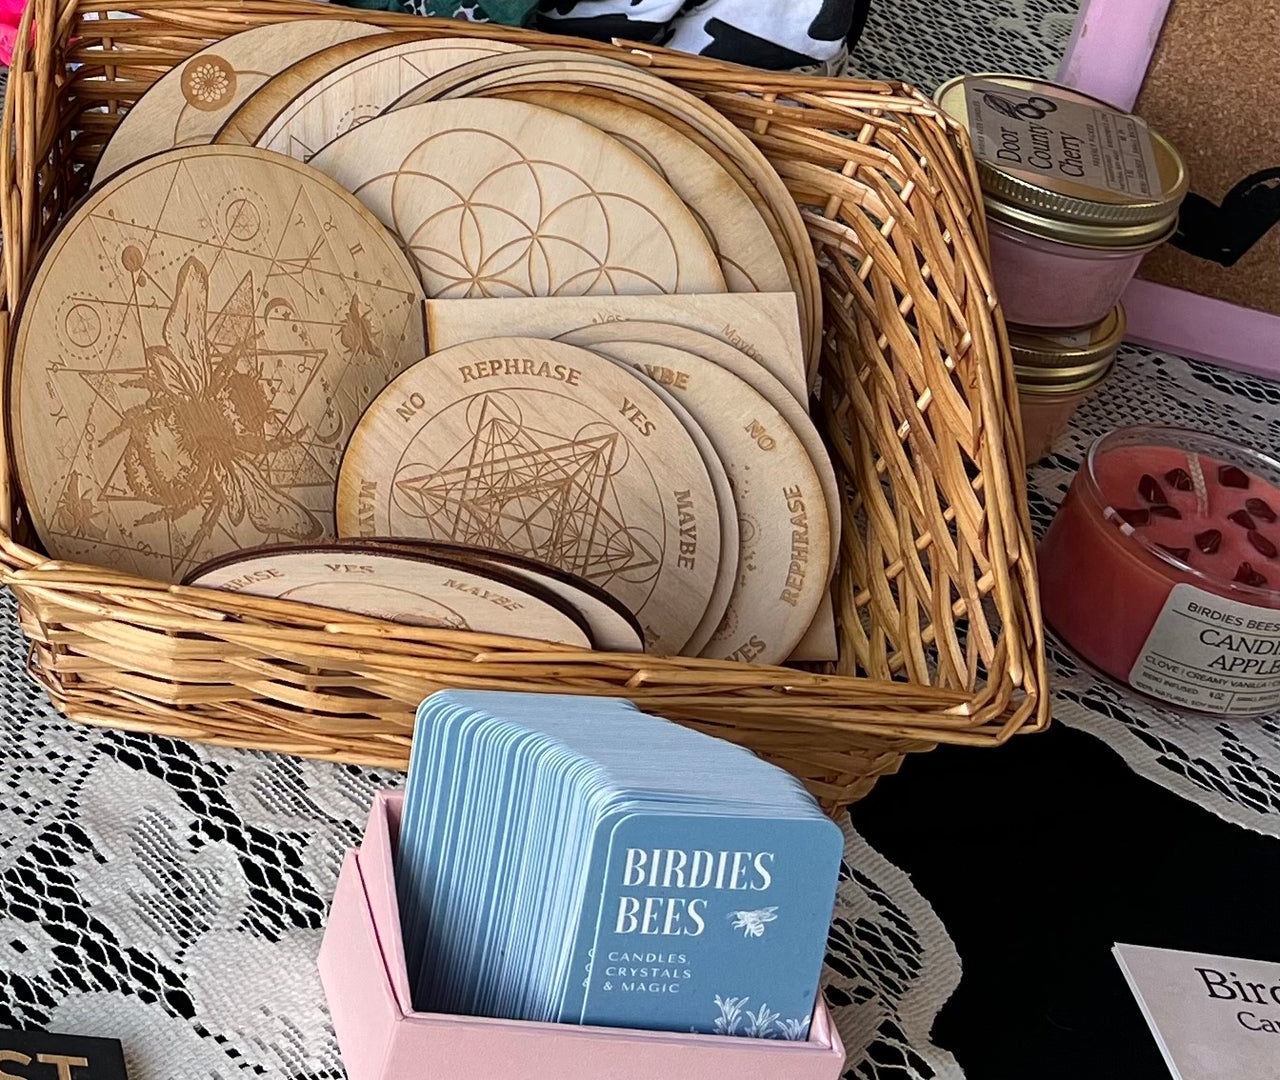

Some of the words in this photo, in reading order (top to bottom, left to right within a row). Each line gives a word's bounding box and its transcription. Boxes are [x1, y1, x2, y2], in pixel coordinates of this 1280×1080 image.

[996, 127, 1022, 164] Door
[1028, 122, 1054, 170] County
[1059, 131, 1085, 177] Cherry
[458, 358, 582, 388] REPHRASE
[395, 391, 426, 423] NO
[618, 397, 657, 438] YES
[743, 418, 777, 452] NO
[674, 489, 696, 571] MAYBE
[779, 483, 811, 608] REPHRASE
[325, 563, 375, 574] YES
[443, 578, 524, 611] MAYBE
[1188, 602, 1244, 626] BIRDIES
[1246, 620, 1280, 631] BEES
[1145, 655, 1179, 673] CLOVE
[622, 848, 774, 891] BIRDIES
[614, 896, 708, 937] BEES
[603, 981, 613, 991] &
[621, 982, 680, 993] MAGIC
[606, 966, 691, 978] CRYSTALS
